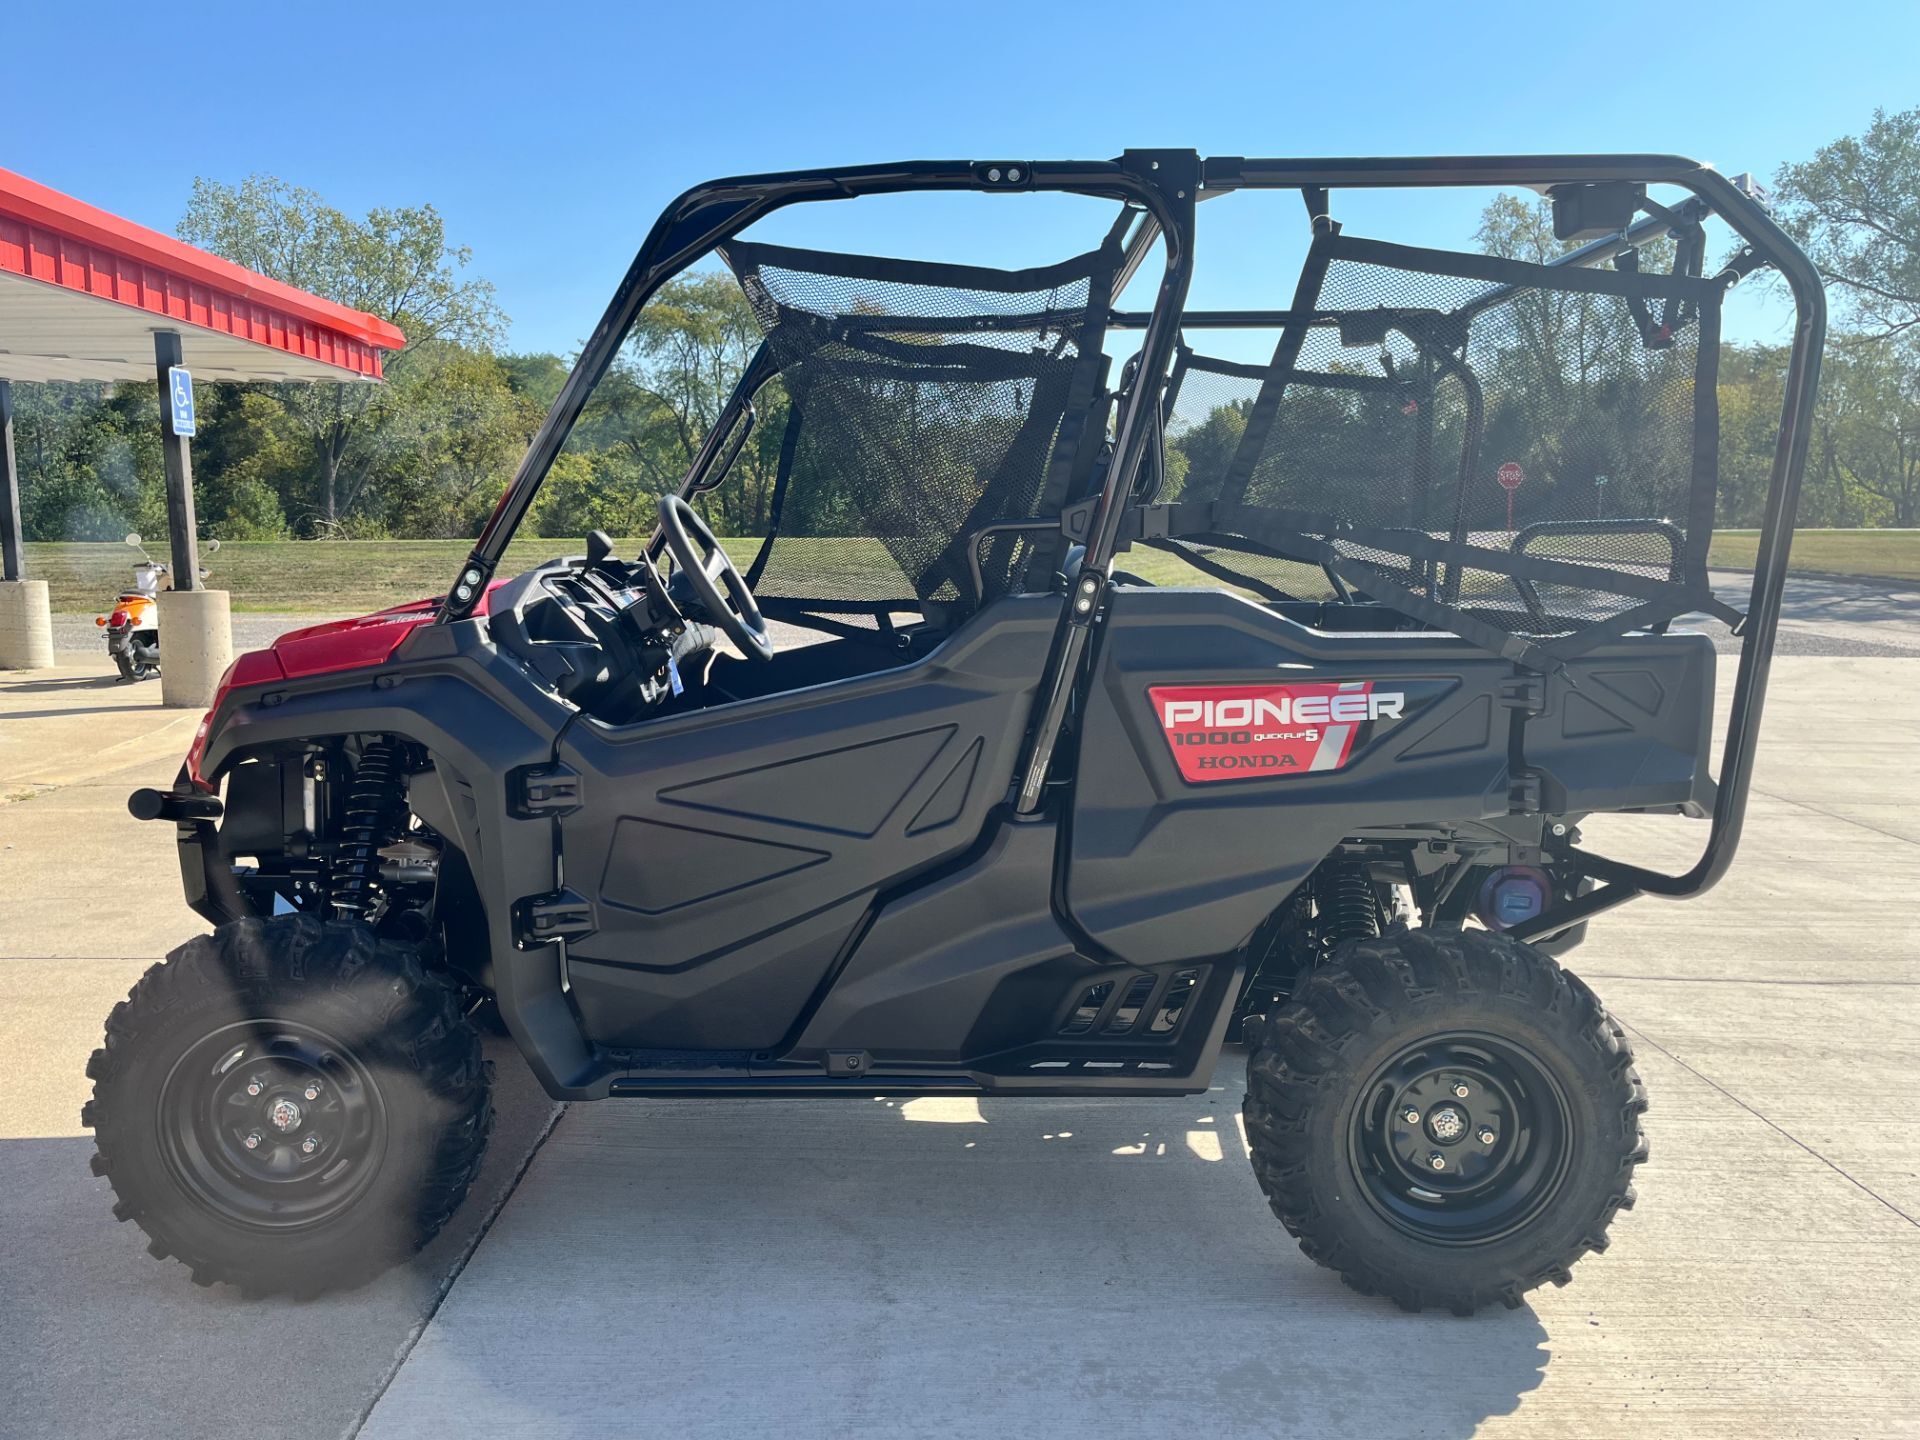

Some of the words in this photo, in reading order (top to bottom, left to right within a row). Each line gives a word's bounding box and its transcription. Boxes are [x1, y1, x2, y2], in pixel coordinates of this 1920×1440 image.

[1499, 470, 1521, 481] STOP
[1164, 692, 1405, 729] PIONEER
[1173, 731, 1251, 746] 1000
[1197, 754, 1299, 769] HONDA
